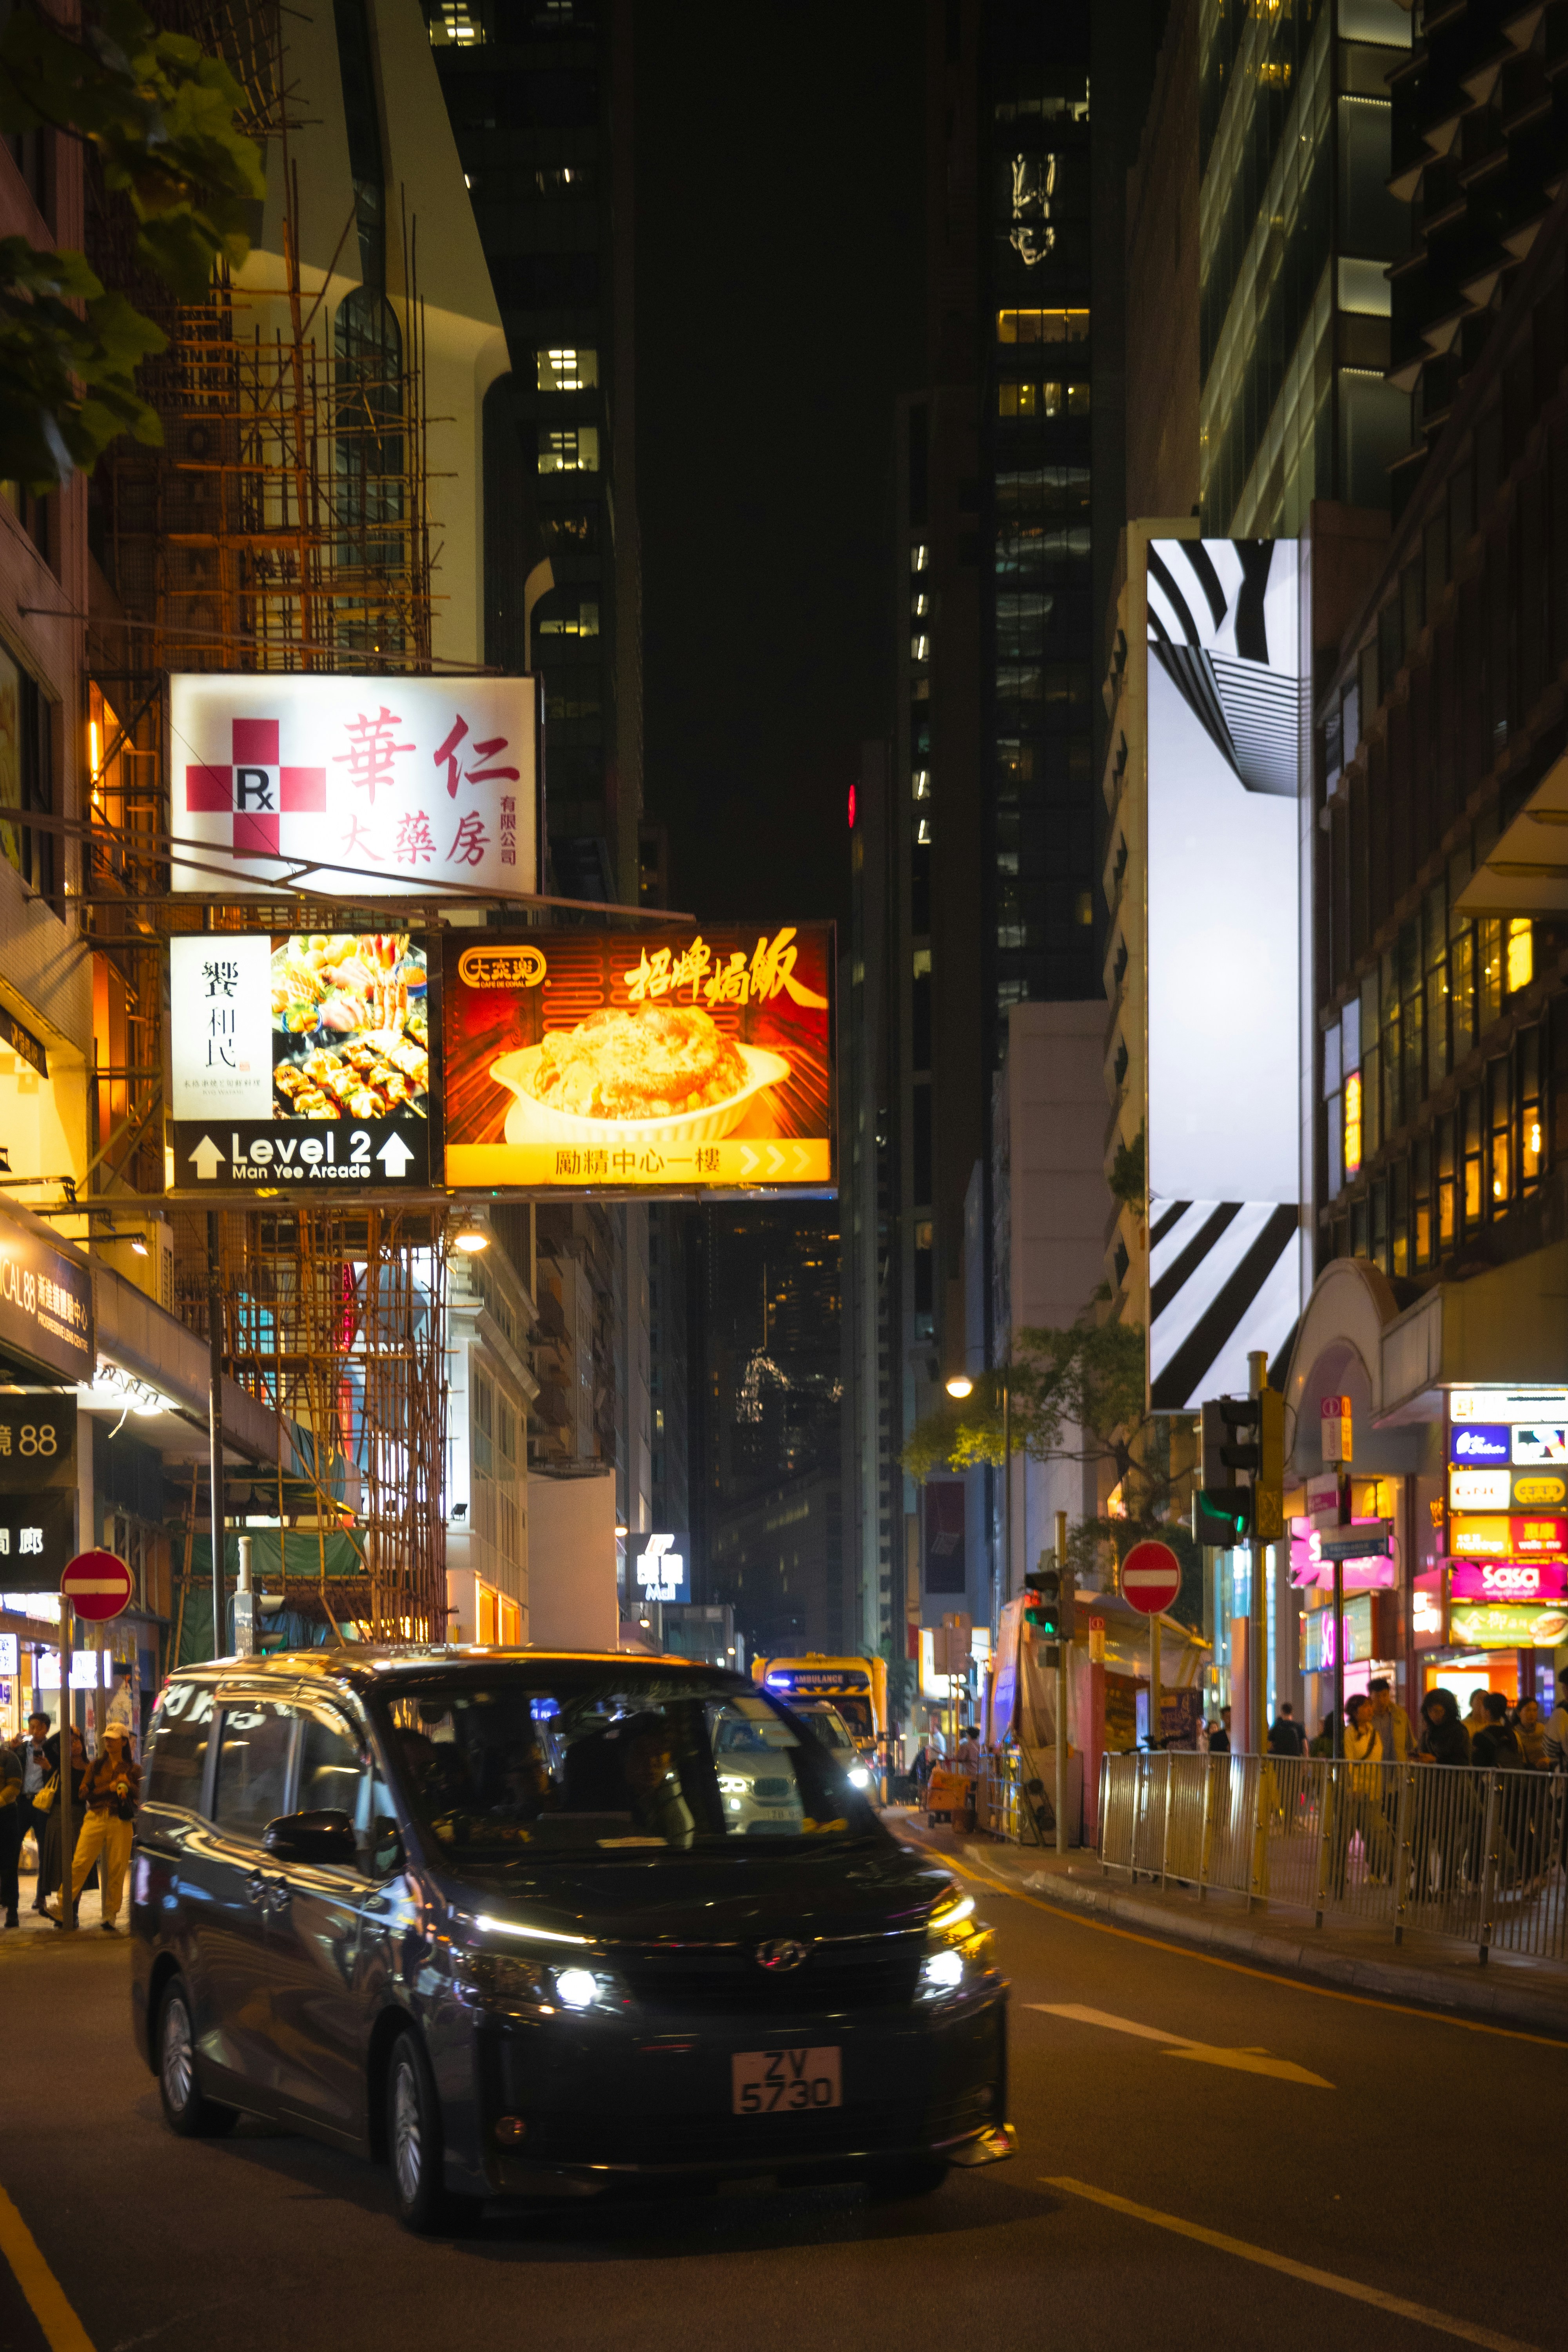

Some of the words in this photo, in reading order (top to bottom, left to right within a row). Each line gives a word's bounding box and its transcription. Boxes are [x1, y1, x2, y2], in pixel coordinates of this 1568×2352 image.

[332, 706, 520, 806] 華仁
[237, 768, 274, 810] Rx
[341, 810, 491, 866] 大藥房
[500, 795, 517, 866] 有限公司
[624, 927, 828, 1009] 招牌焗飯
[201, 962, 239, 1068] 饗和民
[232, 1131, 334, 1164] Level
[350, 1130, 371, 1163] 2
[556, 1147, 720, 1175] 勵精中心一樓
[233, 1164, 268, 1179] Man
[273, 1164, 304, 1179] Yee
[309, 1163, 371, 1178] Arcade
[24, 1270, 36, 1315] 88
[38, 1310, 64, 1340] PROGRESSIVE
[64, 1327, 74, 1345] LENS
[74, 1335, 89, 1354] CENTRE
[1455, 1486, 1502, 1496] GNC
[645, 1583, 676, 1601] Mall
[794, 1674, 843, 1684] AMBULANCE
[764, 2050, 808, 2081] ZV
[741, 2078, 832, 2112] 5730
